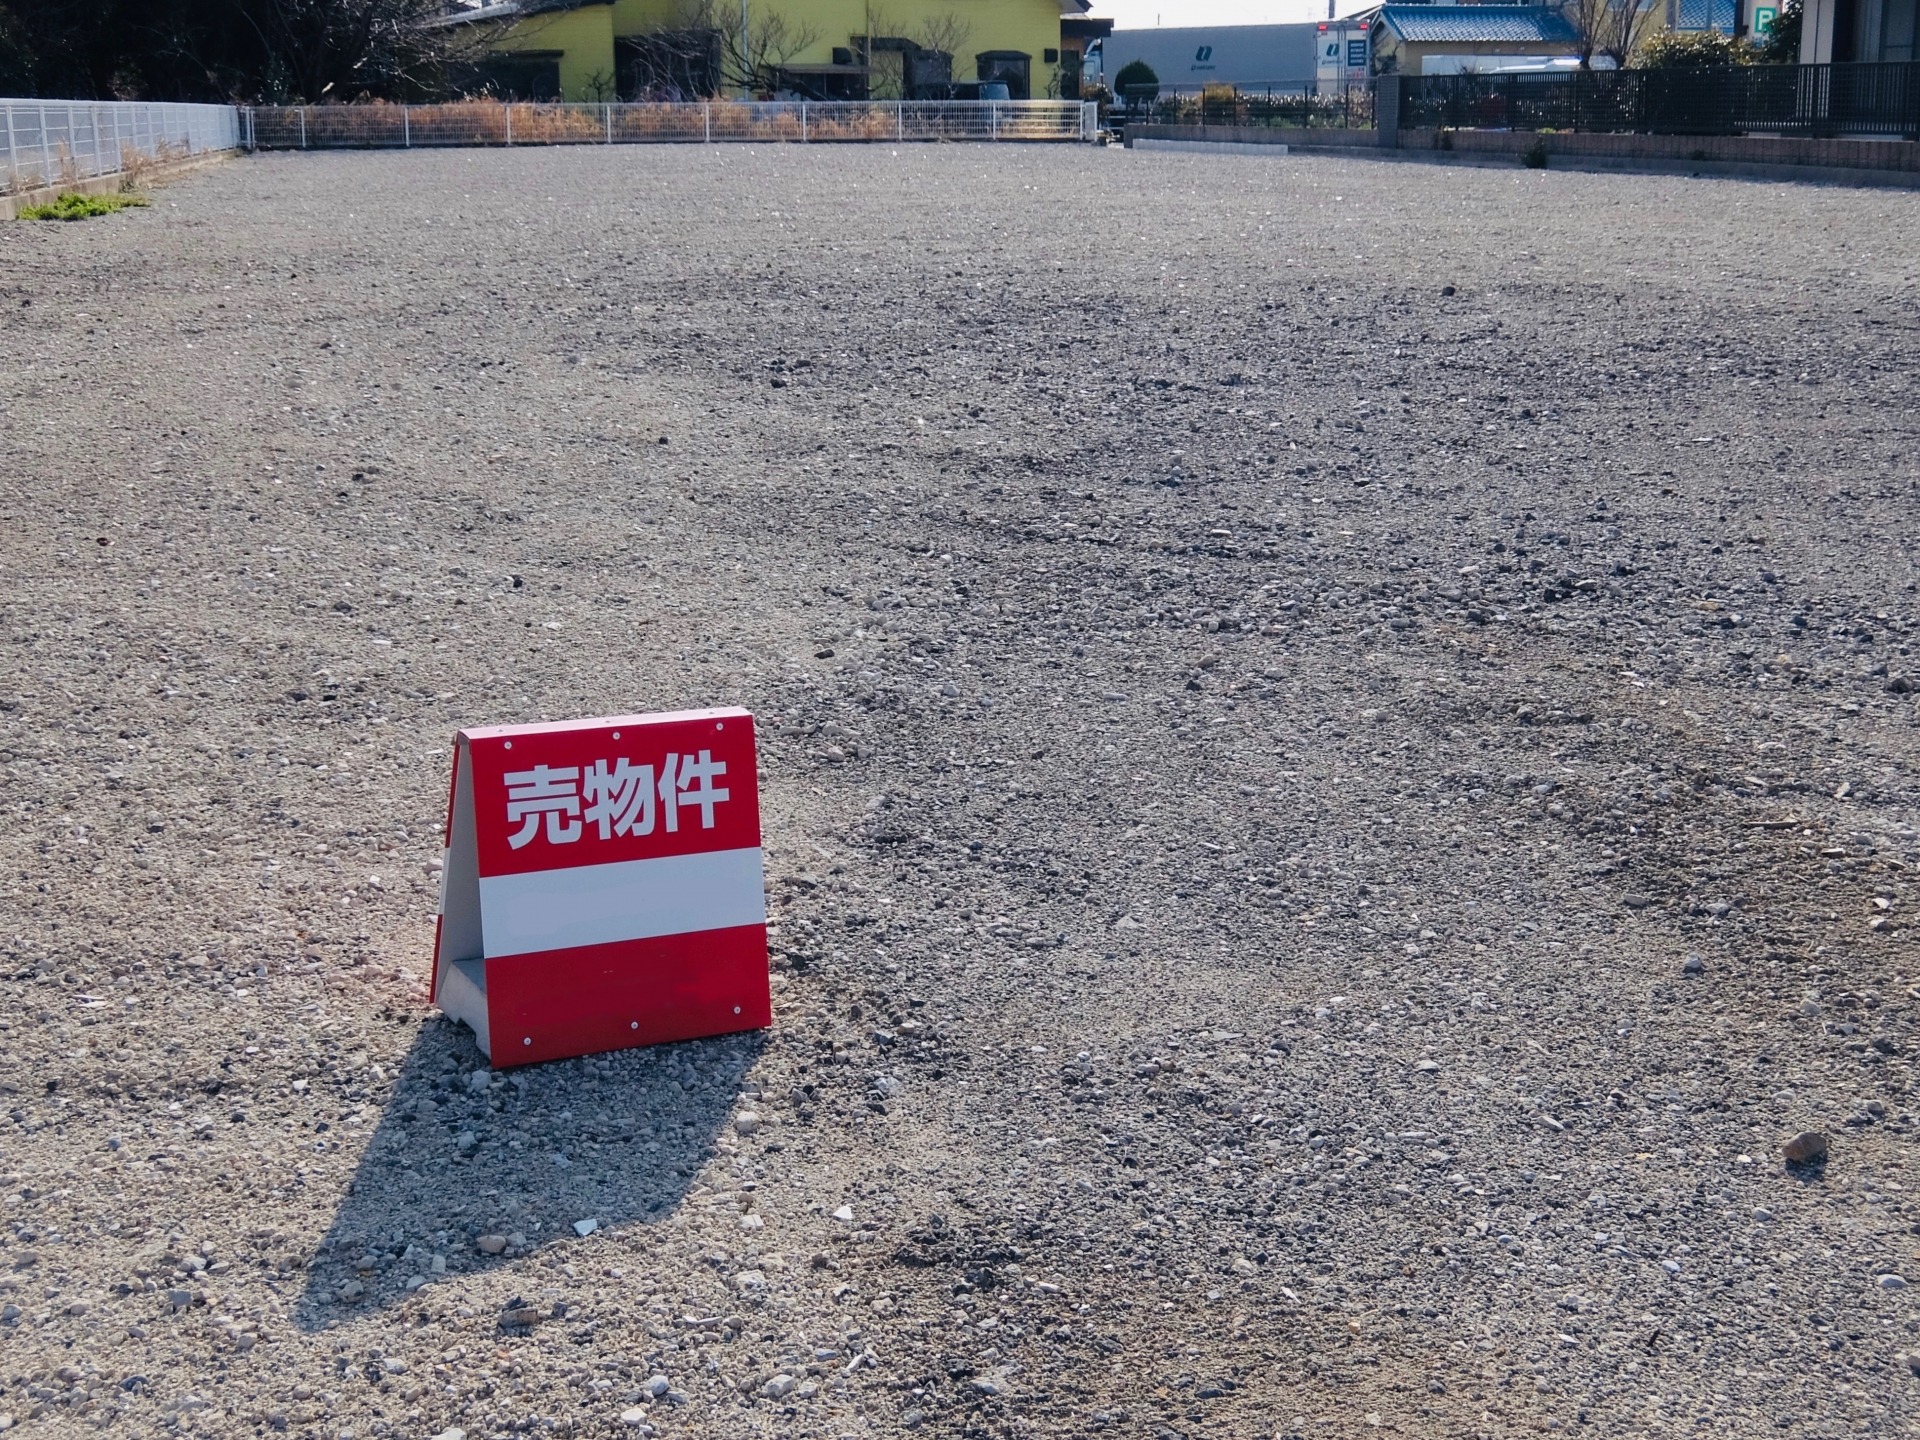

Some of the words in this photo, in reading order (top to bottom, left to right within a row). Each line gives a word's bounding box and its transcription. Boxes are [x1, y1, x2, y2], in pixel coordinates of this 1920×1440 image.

[1759, 10, 1773, 31] P
[503, 749, 730, 850] 売物件
